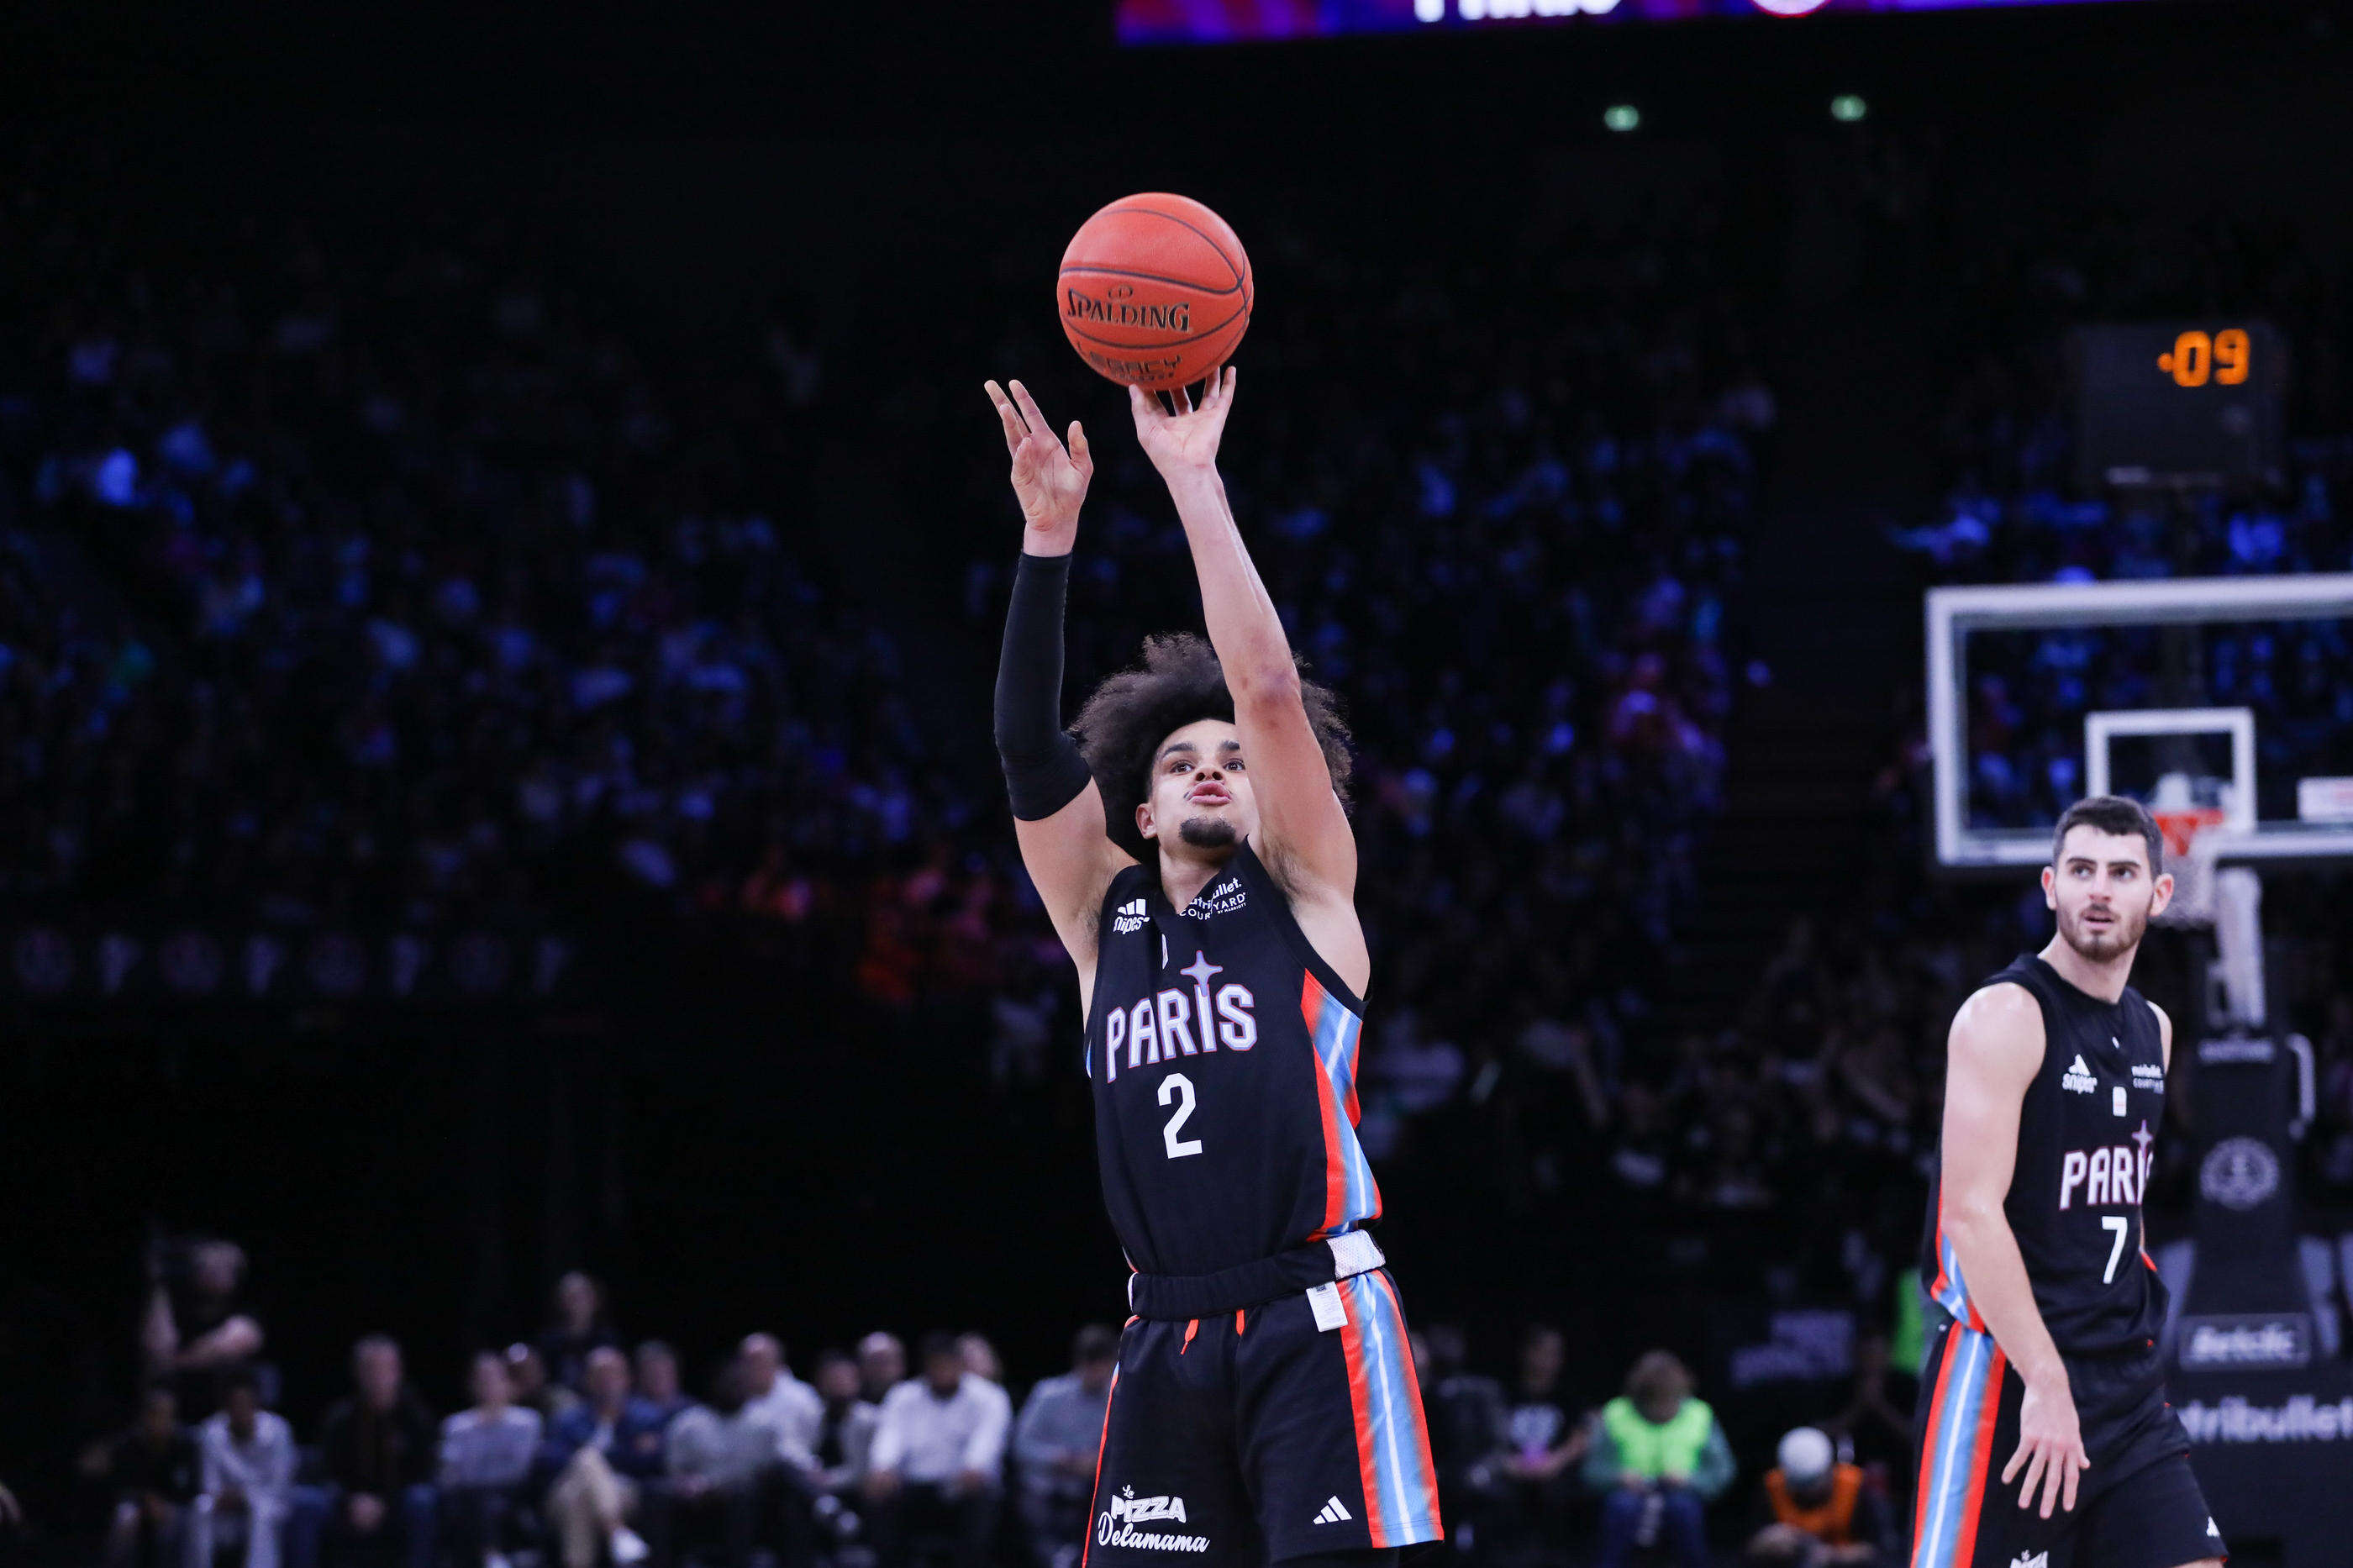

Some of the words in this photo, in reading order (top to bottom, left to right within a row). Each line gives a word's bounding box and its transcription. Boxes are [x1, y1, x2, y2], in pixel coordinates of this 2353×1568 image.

[1067, 287, 1190, 333] SPALDING
[1179, 892, 1246, 920] COURYARD
[1107, 979, 1258, 1084] PARIS
[1157, 1072, 1203, 1160] 2
[2059, 1144, 2154, 1211] PARI
[2101, 1215, 2128, 1285] 7
[1098, 1511, 1211, 1553] Delamama
[1110, 1494, 1187, 1523] PIZZA
